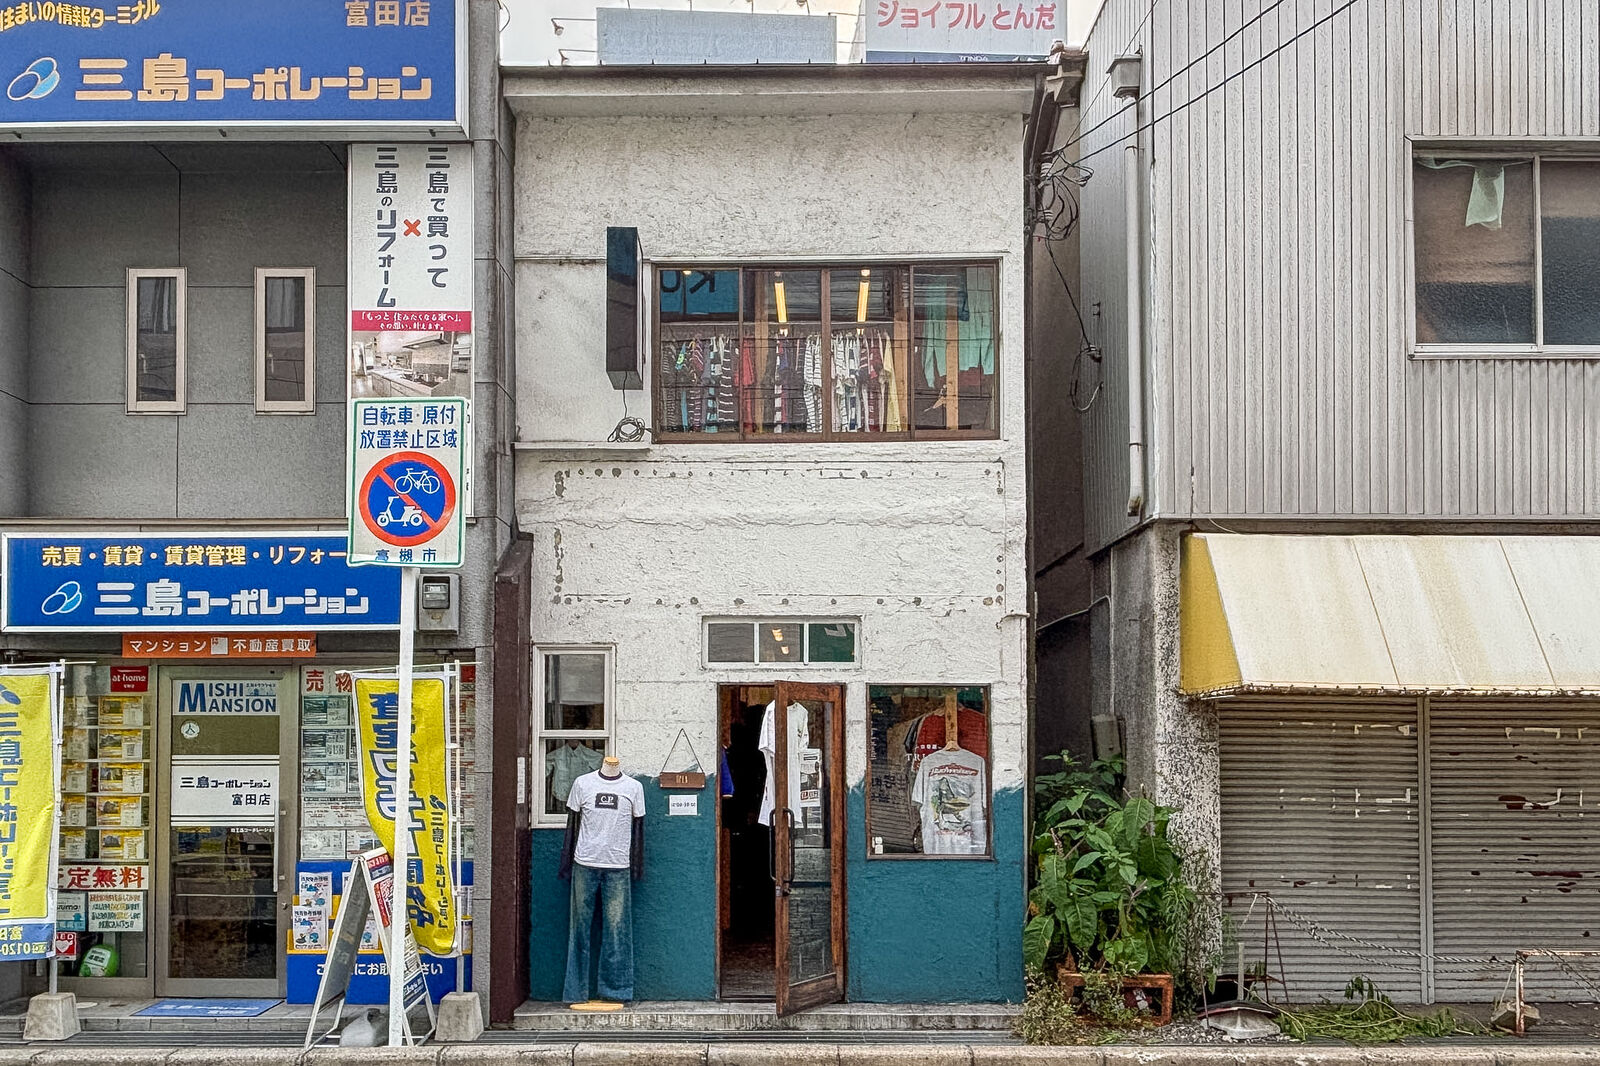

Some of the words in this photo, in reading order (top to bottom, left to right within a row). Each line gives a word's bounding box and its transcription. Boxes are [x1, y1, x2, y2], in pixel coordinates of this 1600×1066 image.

[345, 0, 430, 27] 富田店
[878, 1, 986, 30] ジョイフル
[992, 3, 1056, 30] とんだ
[75, 53, 432, 102] 三島コーポレーション
[374, 147, 399, 308] 三島のリフォーム
[425, 147, 450, 288] 三島で買って
[363, 405, 456, 426] 自転車・原付
[360, 429, 458, 449] 放置禁止区域
[374, 547, 438, 563] 高槻市
[94, 578, 369, 616] 三島コーポレーション
[129, 639, 207, 653] マンション
[233, 639, 312, 653] 不動産買取
[180, 776, 271, 789] 三島コーポレーション
[232, 793, 271, 806] 富田店
